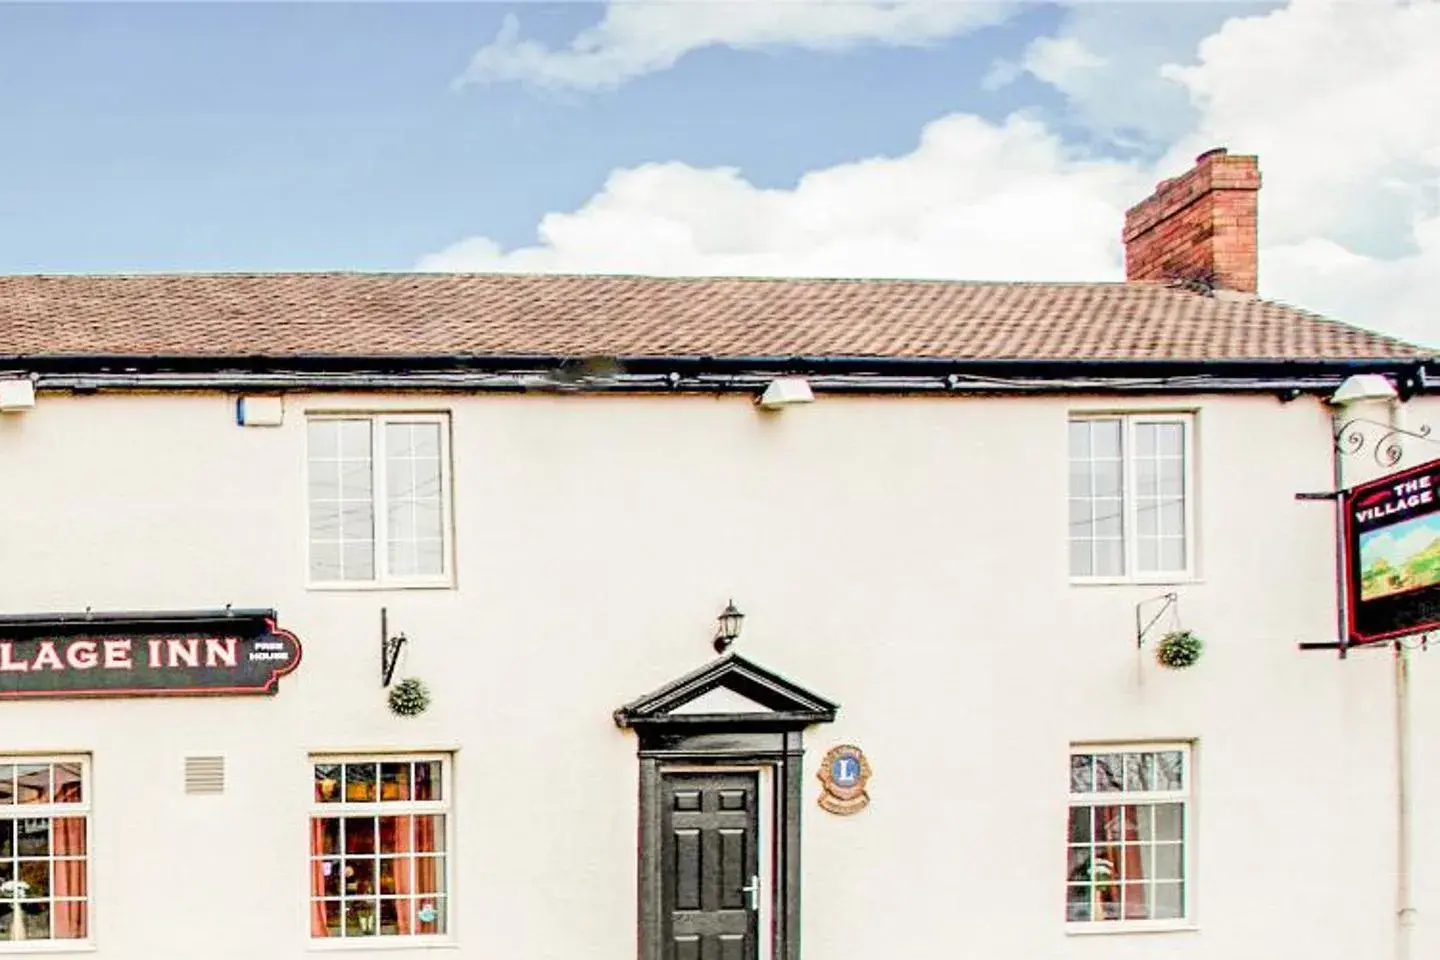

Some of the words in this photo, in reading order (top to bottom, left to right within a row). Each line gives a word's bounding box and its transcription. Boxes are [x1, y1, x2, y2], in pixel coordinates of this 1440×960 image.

[1393, 475, 1432, 496] THE
[1355, 490, 1433, 523] VILLAGE
[147, 637, 238, 668] INN
[249, 652, 289, 661] HOUSE
